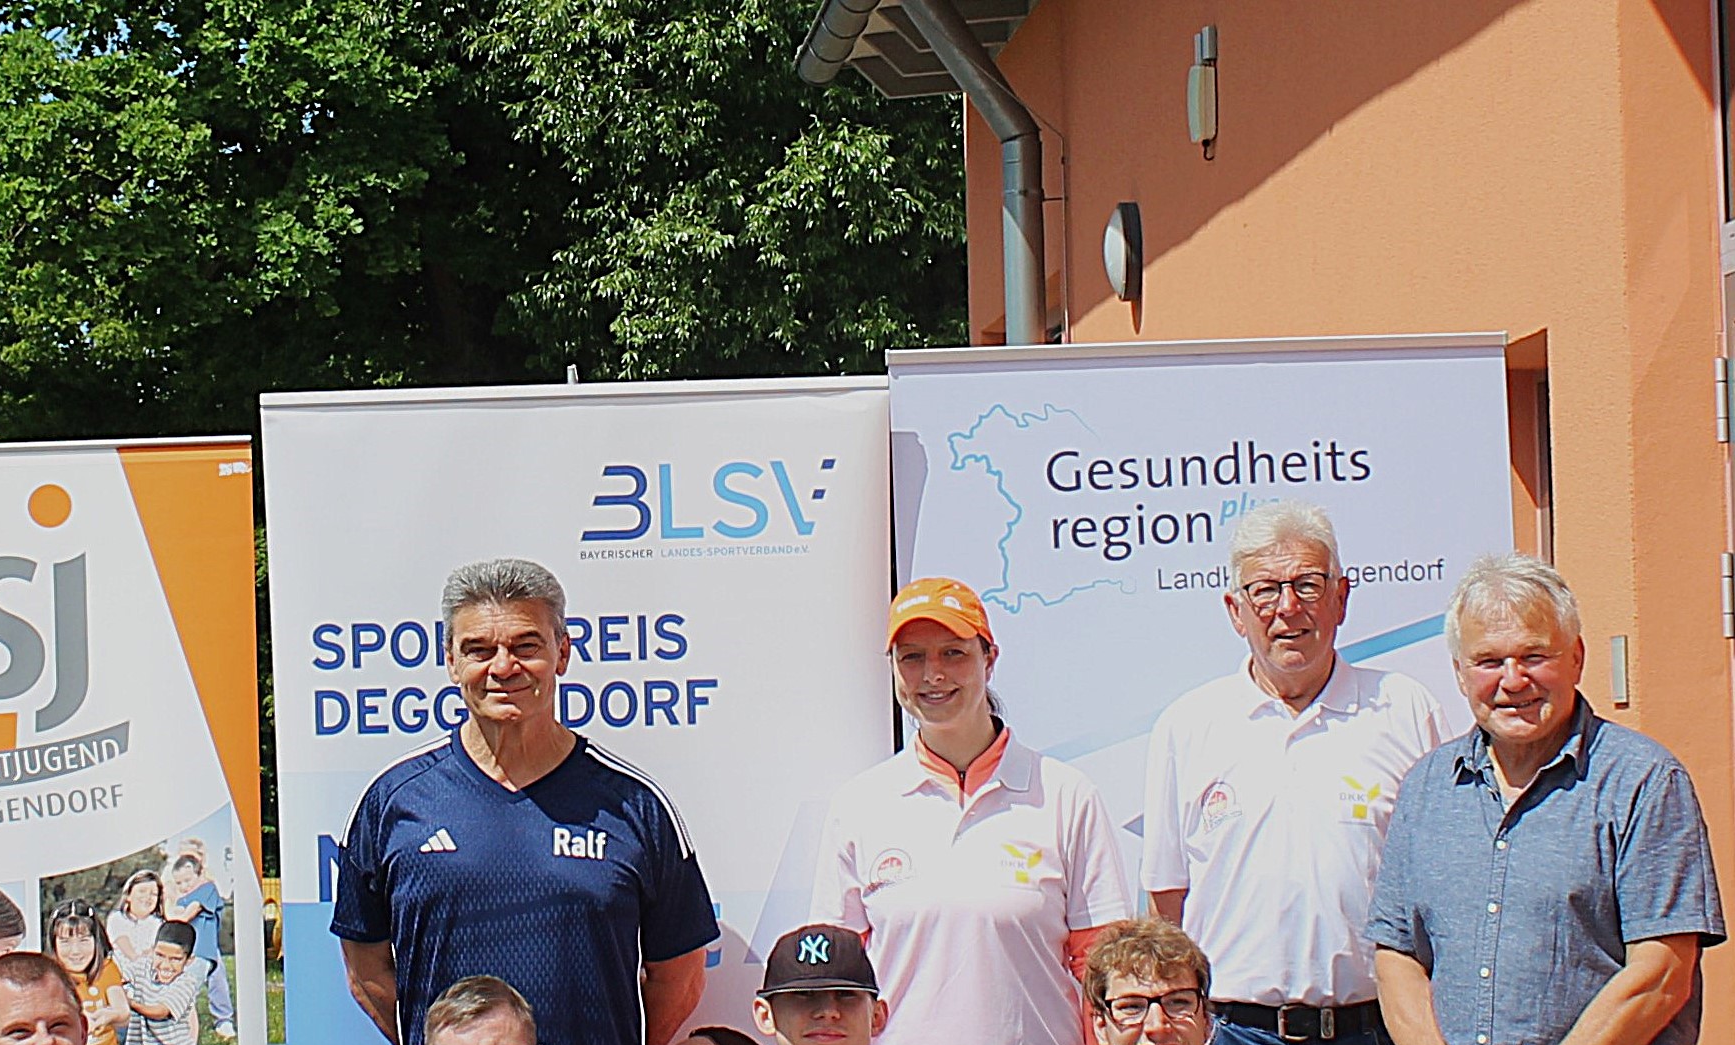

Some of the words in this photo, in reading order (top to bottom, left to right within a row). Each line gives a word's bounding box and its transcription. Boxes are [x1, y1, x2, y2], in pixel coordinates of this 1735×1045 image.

[1045, 440, 1372, 492] Gesundheits
[580, 458, 837, 542] BLSV
[1219, 491, 1281, 525] pl
[580, 549, 654, 560] BAYERISCHER
[1051, 504, 1214, 562] region
[312, 614, 688, 671] SPOREIS
[315, 678, 719, 736] DEGGDORF
[552, 826, 607, 861] Ralf
[798, 934, 830, 964] NY
